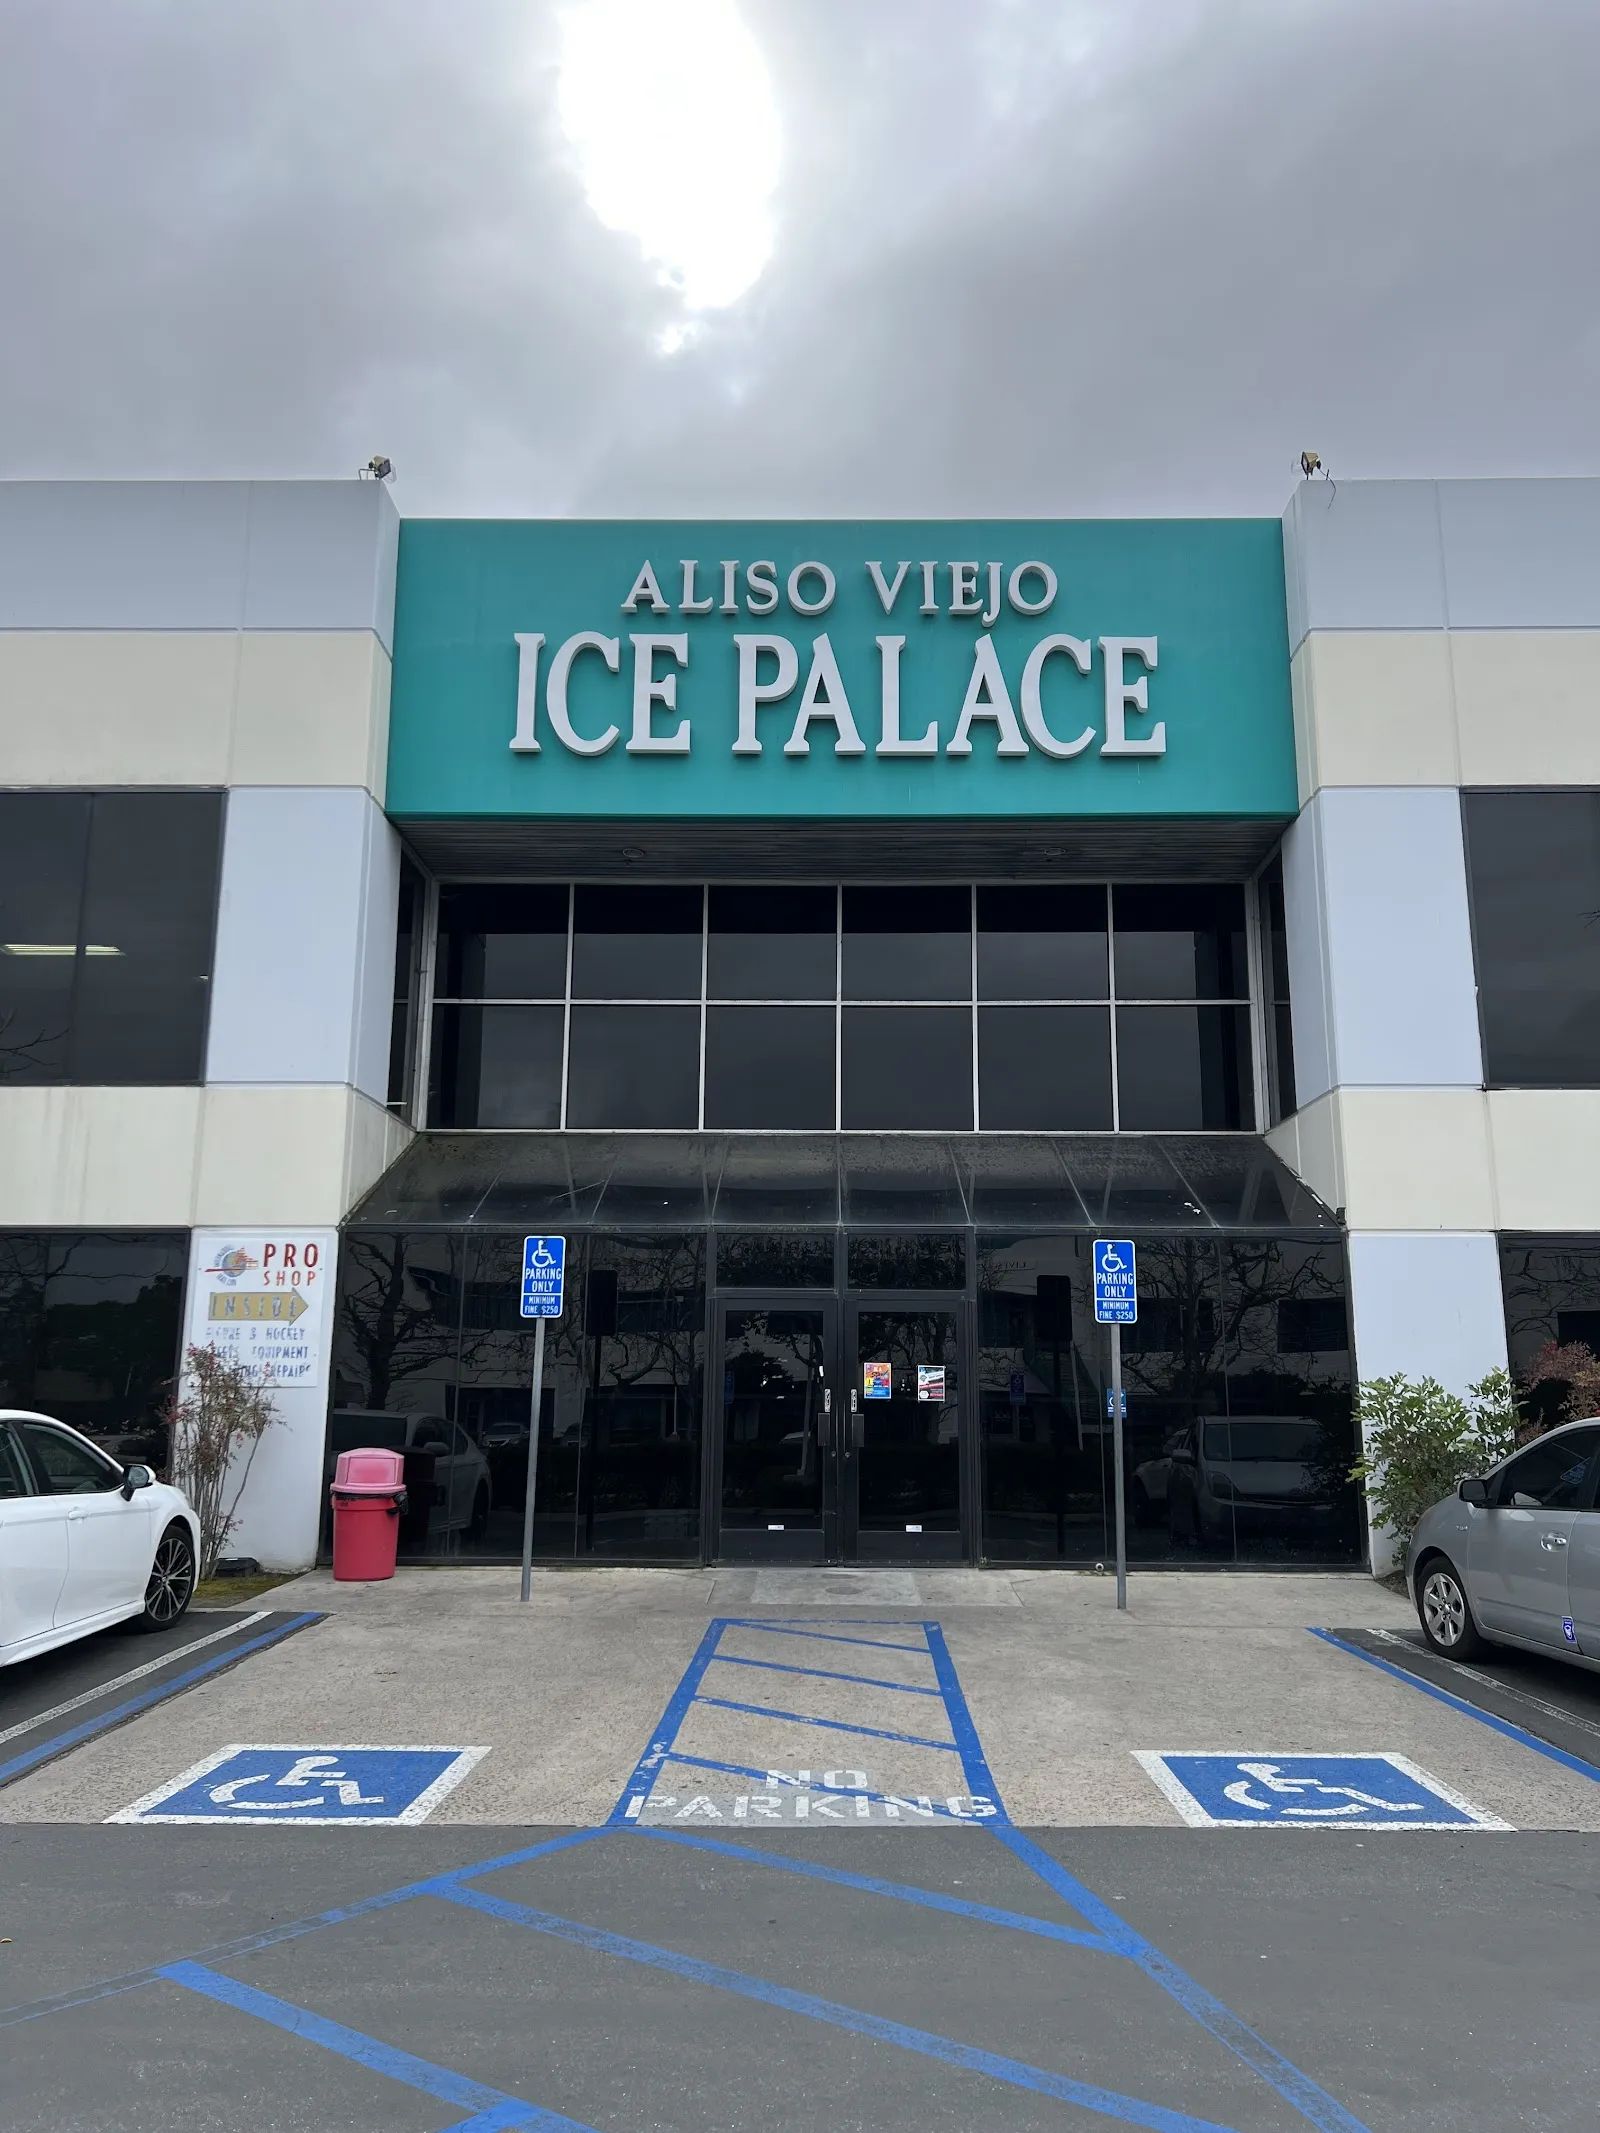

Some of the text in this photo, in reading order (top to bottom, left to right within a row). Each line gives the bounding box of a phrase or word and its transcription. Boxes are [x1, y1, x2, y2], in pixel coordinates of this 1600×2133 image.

[620, 558, 1059, 627] ALISO VIEJO
[508, 630, 1168, 759] ICE PALACE
[264, 1243, 318, 1267] PRO
[263, 1270, 316, 1287] SHOP
[525, 1267, 562, 1280] PARKING
[1096, 1272, 1134, 1285] PARKING
[532, 1281, 554, 1292] ONLY
[1104, 1285, 1127, 1298] ONLY
[211, 1295, 297, 1317] INSIDE
[529, 1296, 555, 1304] MINIMUM
[1102, 1301, 1130, 1310] MINIMUM
[524, 1305, 559, 1315] FINE $250
[1099, 1310, 1134, 1320] FINE $250
[266, 1327, 306, 1341] HOCKEY
[252, 1346, 309, 1359] EQUIPMENT
[765, 1769, 869, 1789] NO
[624, 1795, 998, 1818] PARKING
